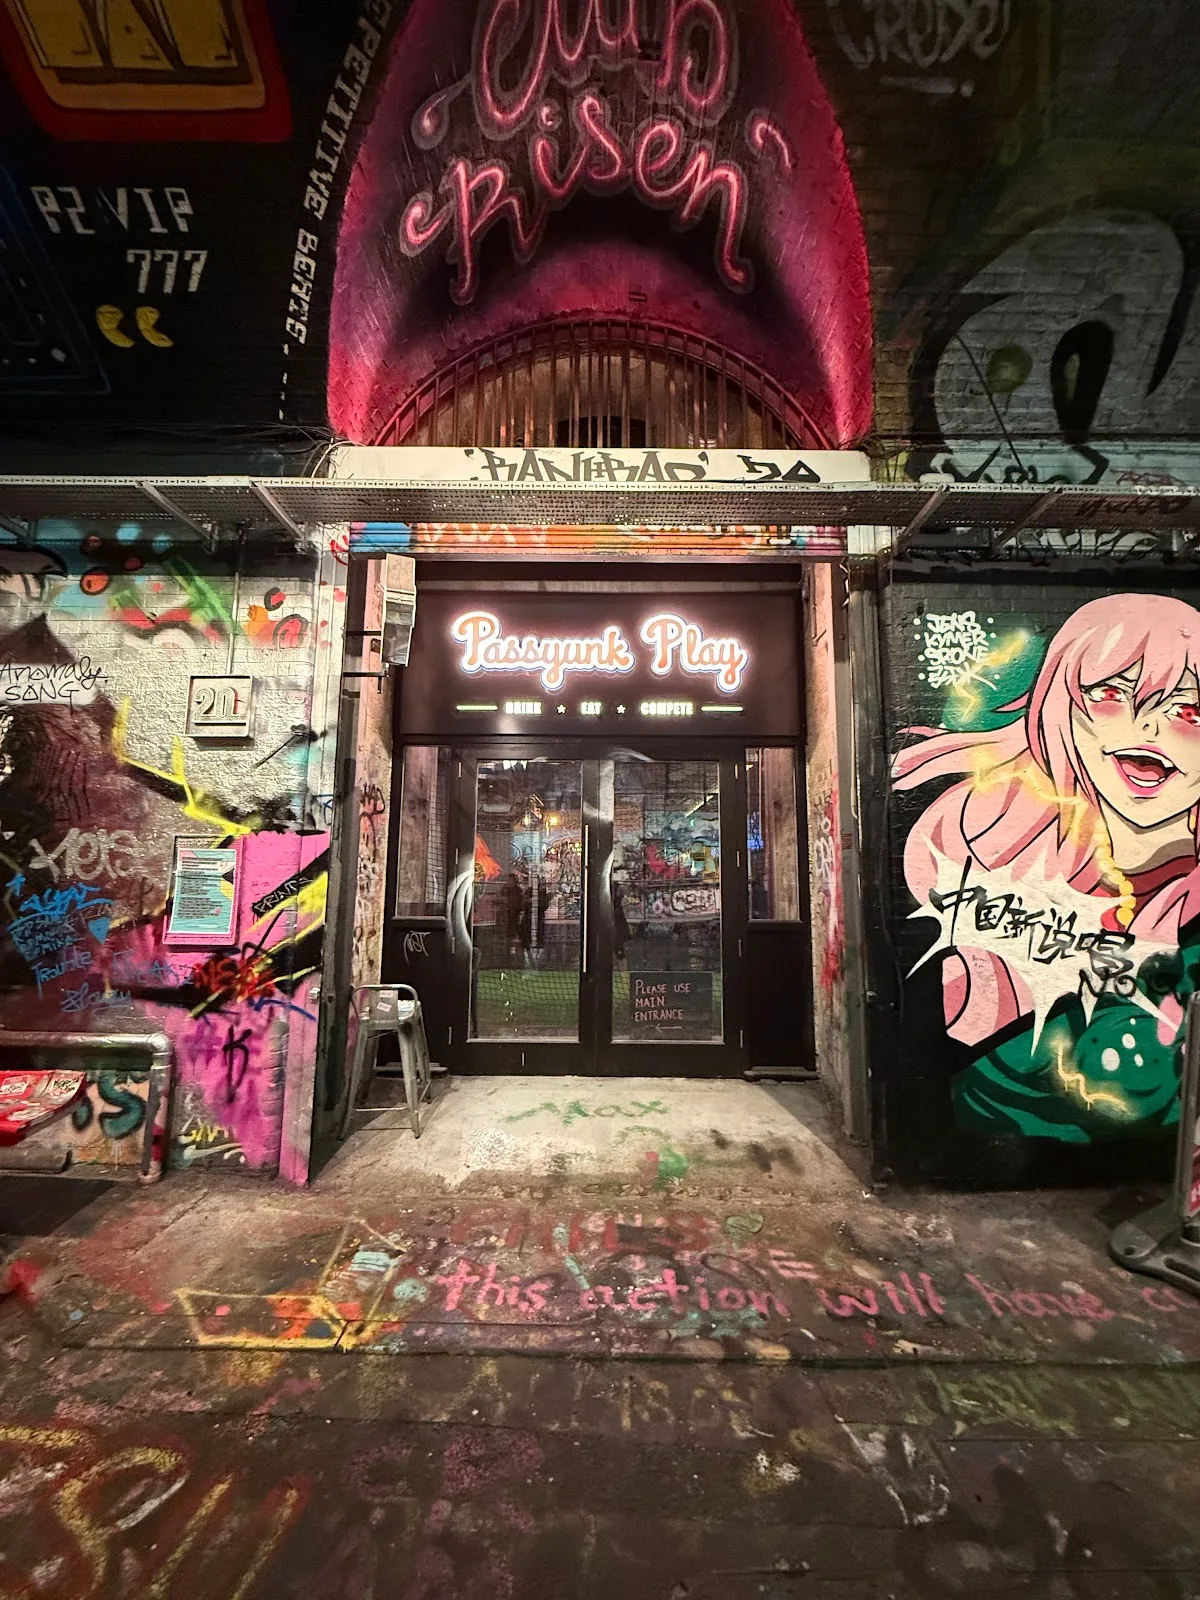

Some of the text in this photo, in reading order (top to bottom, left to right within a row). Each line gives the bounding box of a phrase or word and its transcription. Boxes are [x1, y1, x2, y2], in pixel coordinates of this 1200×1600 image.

[97, 186, 194, 234] VIP
[126, 249, 208, 294] 777
[284, 227, 319, 344] BEATS
[452, 610, 749, 694] Passyunk Play
[5, 679, 80, 716] SONG
[505, 701, 694, 715] DRINK EAT COMPETE
[928, 855, 1137, 979] 中国新说唱
[635, 979, 692, 997] PLEASE USE
[635, 996, 665, 1008] MAIN
[634, 1009, 684, 1022] ENTRANCE
[437, 1258, 552, 1313] this
[579, 1267, 791, 1318] action
[816, 1271, 944, 1317] will
[964, 1272, 1116, 1322] have
